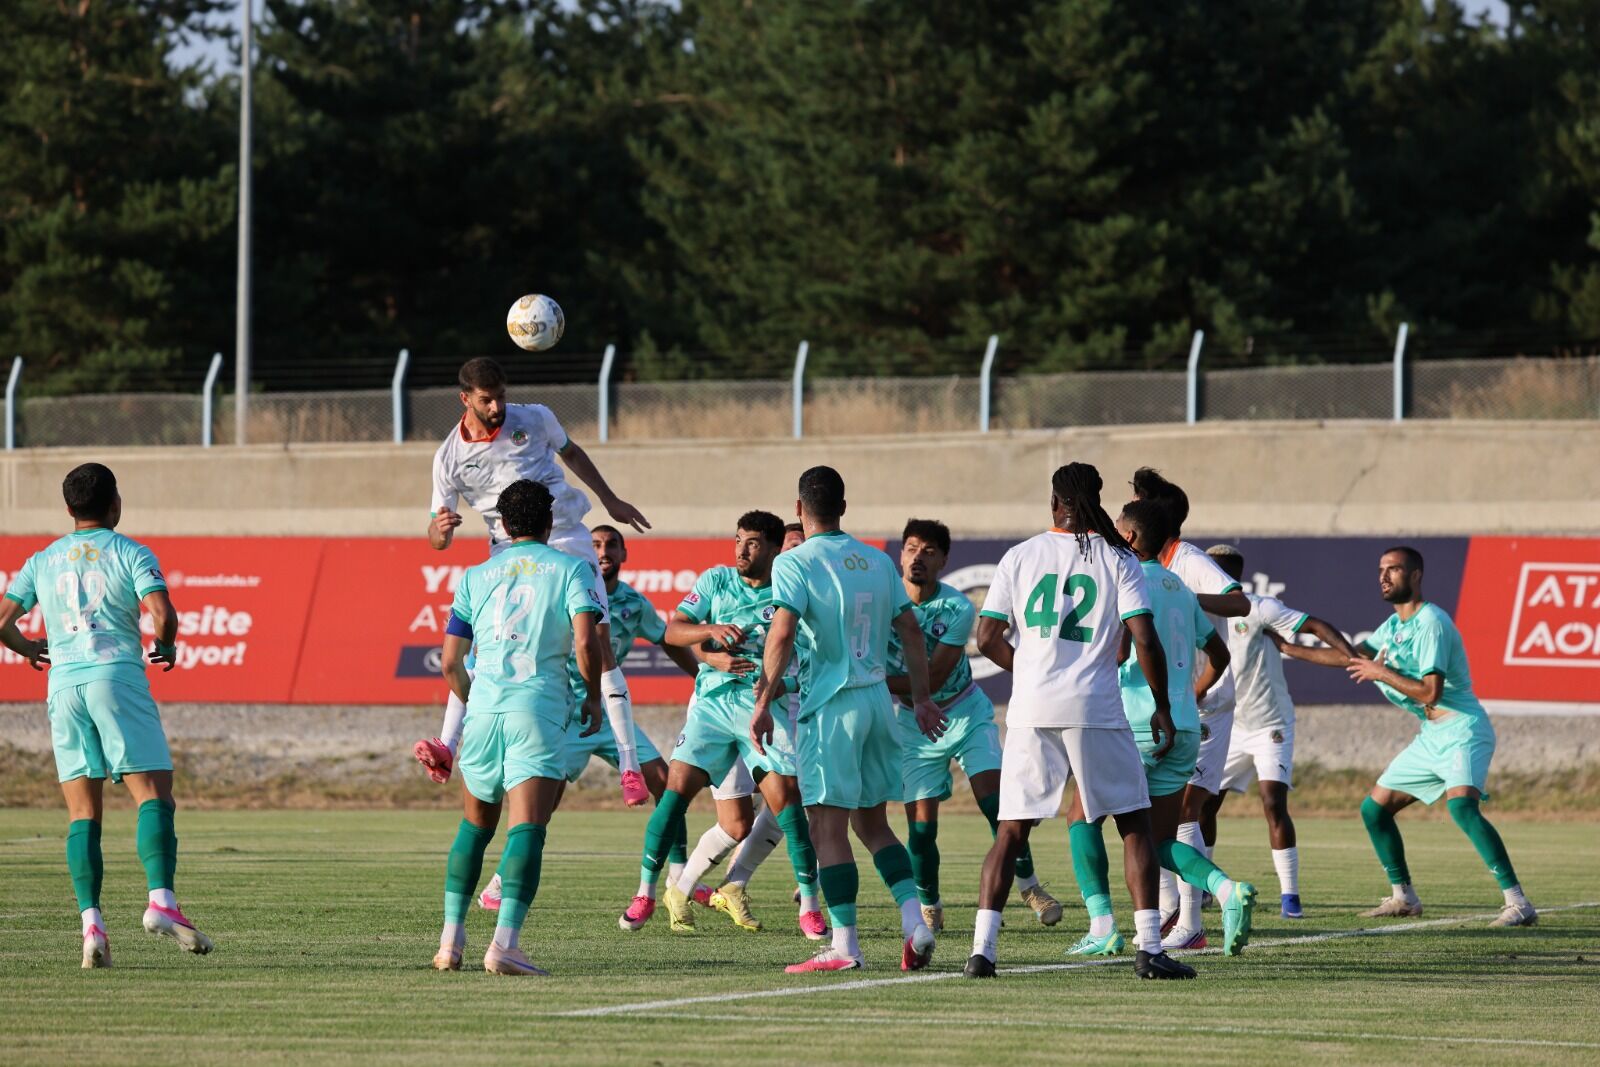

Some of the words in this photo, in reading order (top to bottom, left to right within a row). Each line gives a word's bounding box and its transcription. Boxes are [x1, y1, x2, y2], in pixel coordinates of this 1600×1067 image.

[56, 570, 108, 634] 32
[493, 583, 535, 643] 12
[851, 592, 873, 659] 5
[1024, 573, 1098, 643] 42
